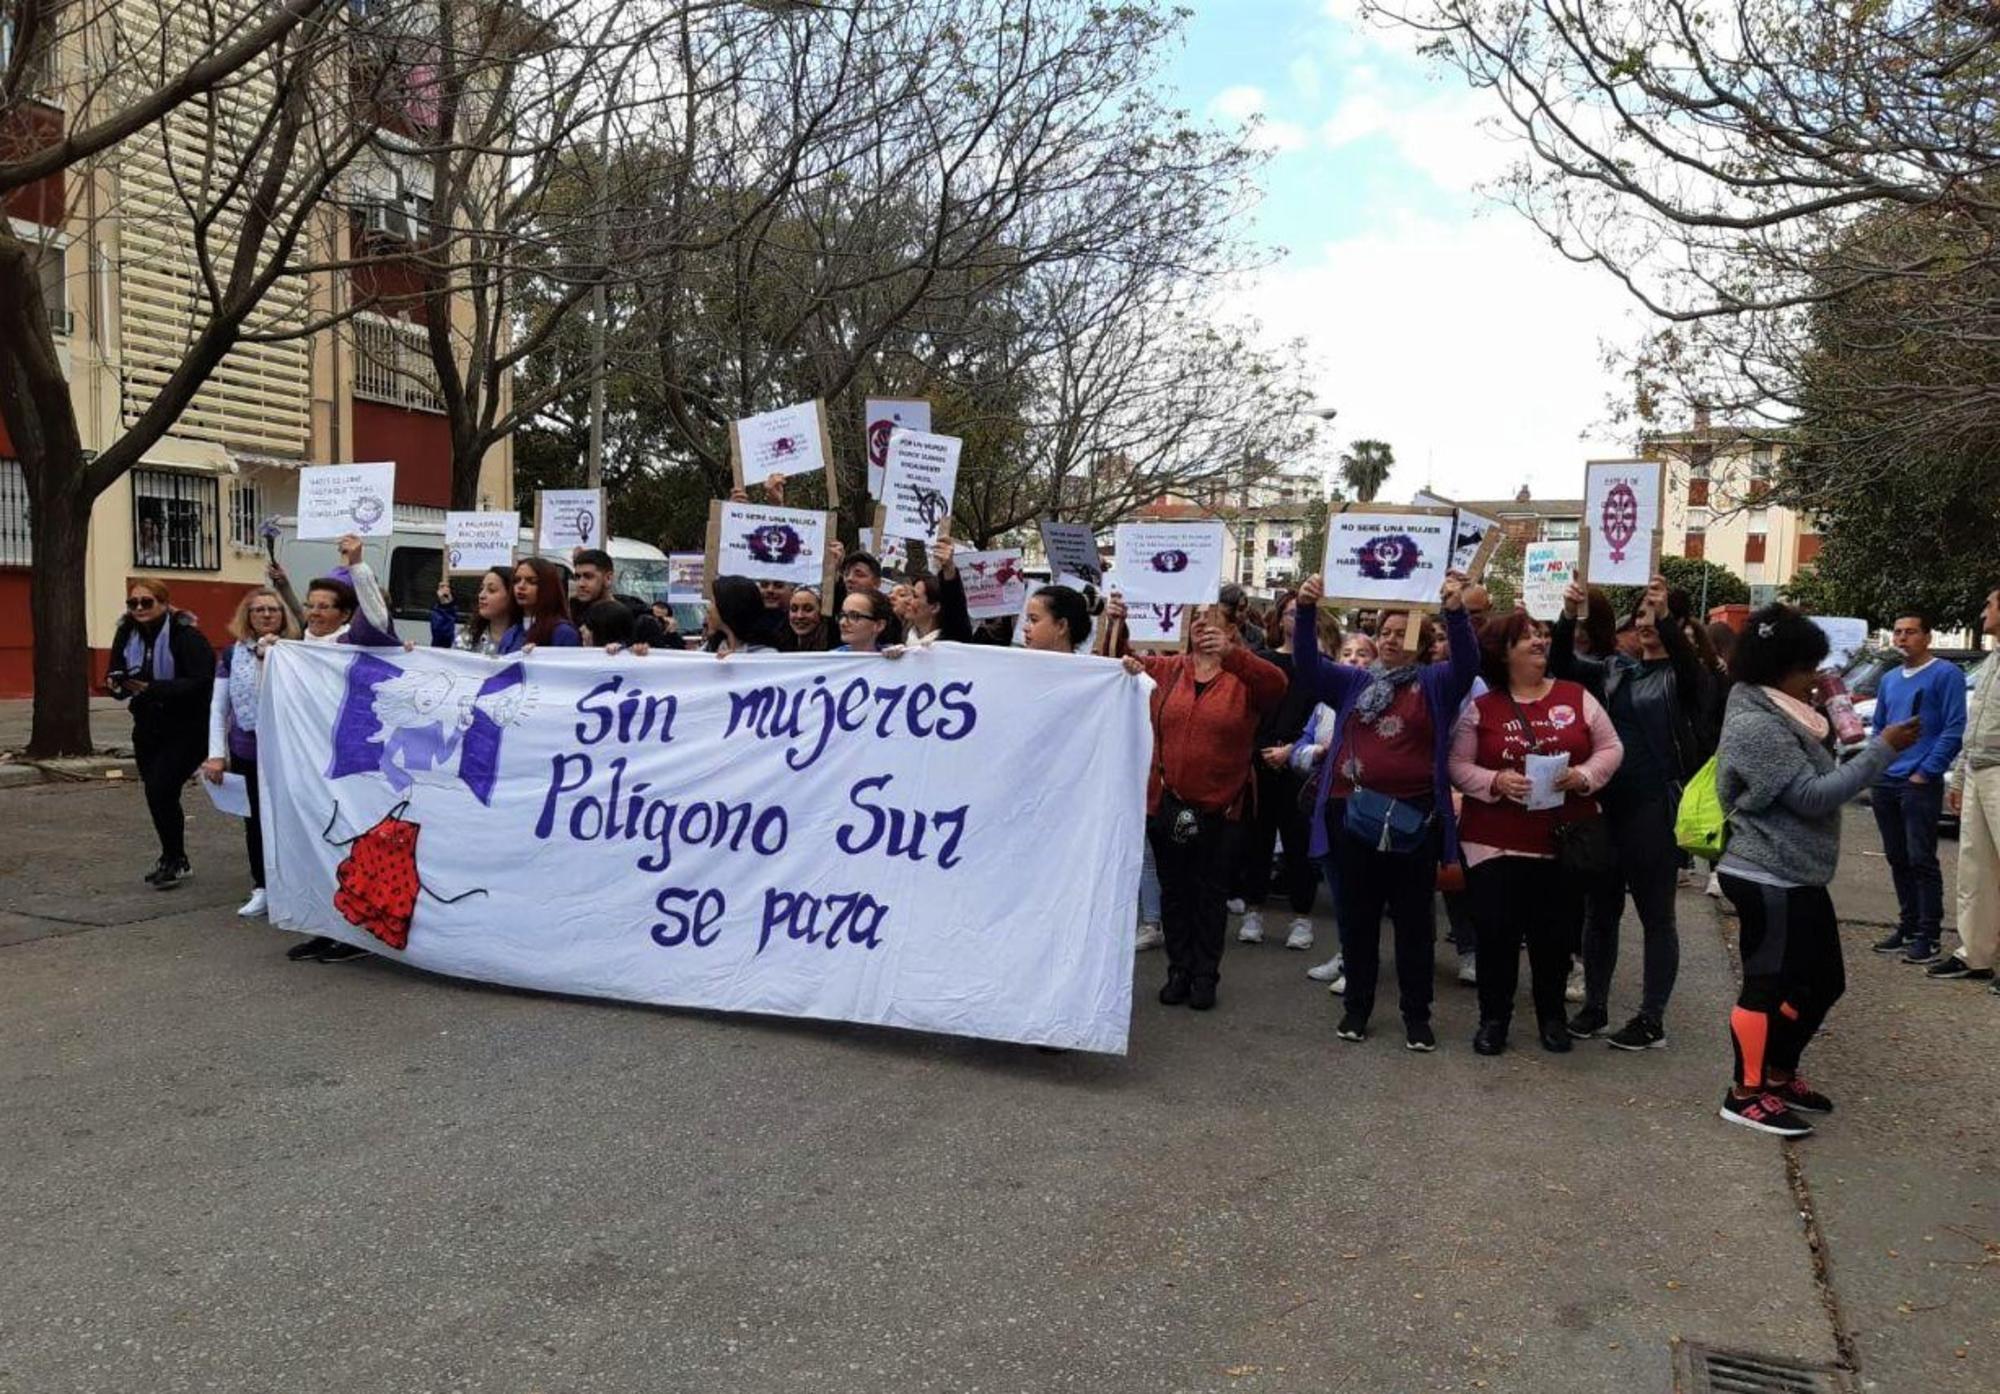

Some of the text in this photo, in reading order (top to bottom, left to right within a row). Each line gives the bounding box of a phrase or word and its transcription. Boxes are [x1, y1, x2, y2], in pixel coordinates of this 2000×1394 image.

[1341, 523, 1354, 531] NO
[1384, 525, 1404, 533] UNA
[1407, 526, 1441, 534] MUJER
[1547, 561, 1563, 572] NO
[577, 675, 977, 771] Sin mujeres
[836, 774, 970, 869] Sur
[651, 887, 889, 956] se para
